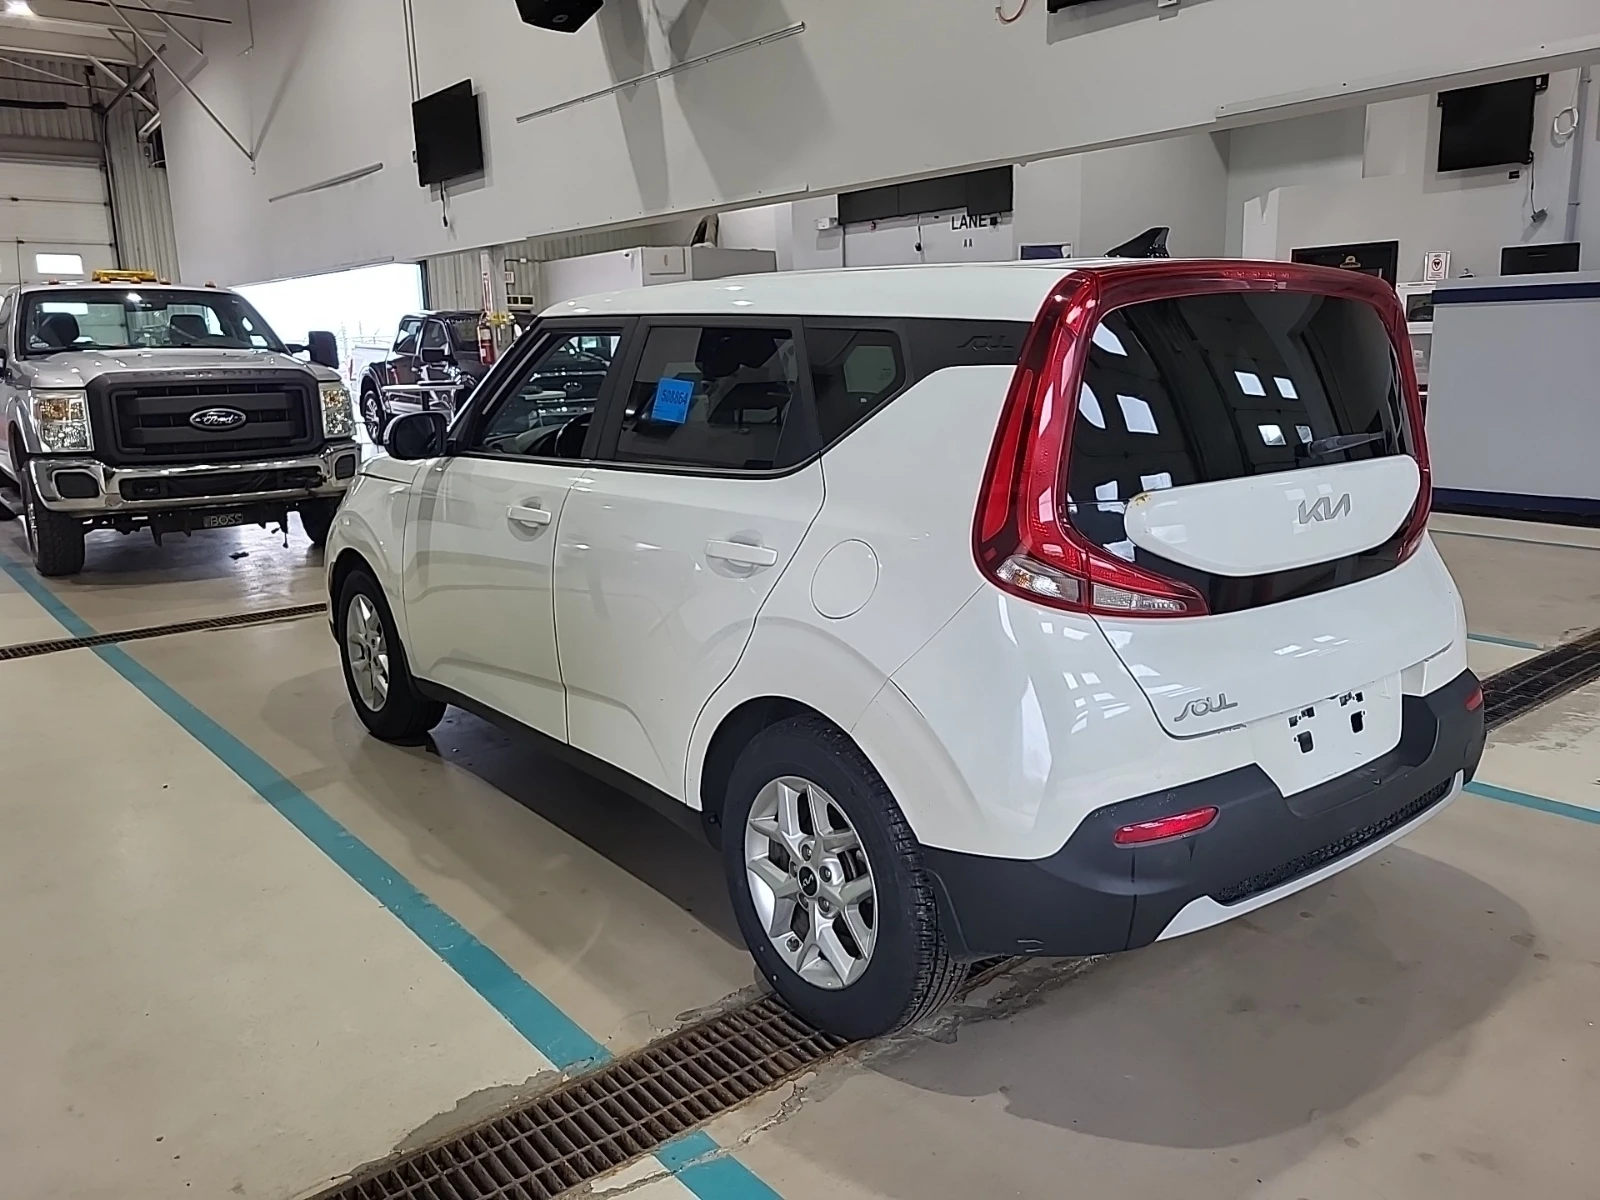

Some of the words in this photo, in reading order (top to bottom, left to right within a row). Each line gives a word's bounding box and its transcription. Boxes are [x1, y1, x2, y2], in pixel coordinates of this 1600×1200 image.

[951, 214, 988, 230] LANE
[202, 411, 234, 425] Ford
[1298, 493, 1350, 524] KIA
[210, 513, 243, 527] BOSS
[1174, 693, 1238, 722] SOUL
